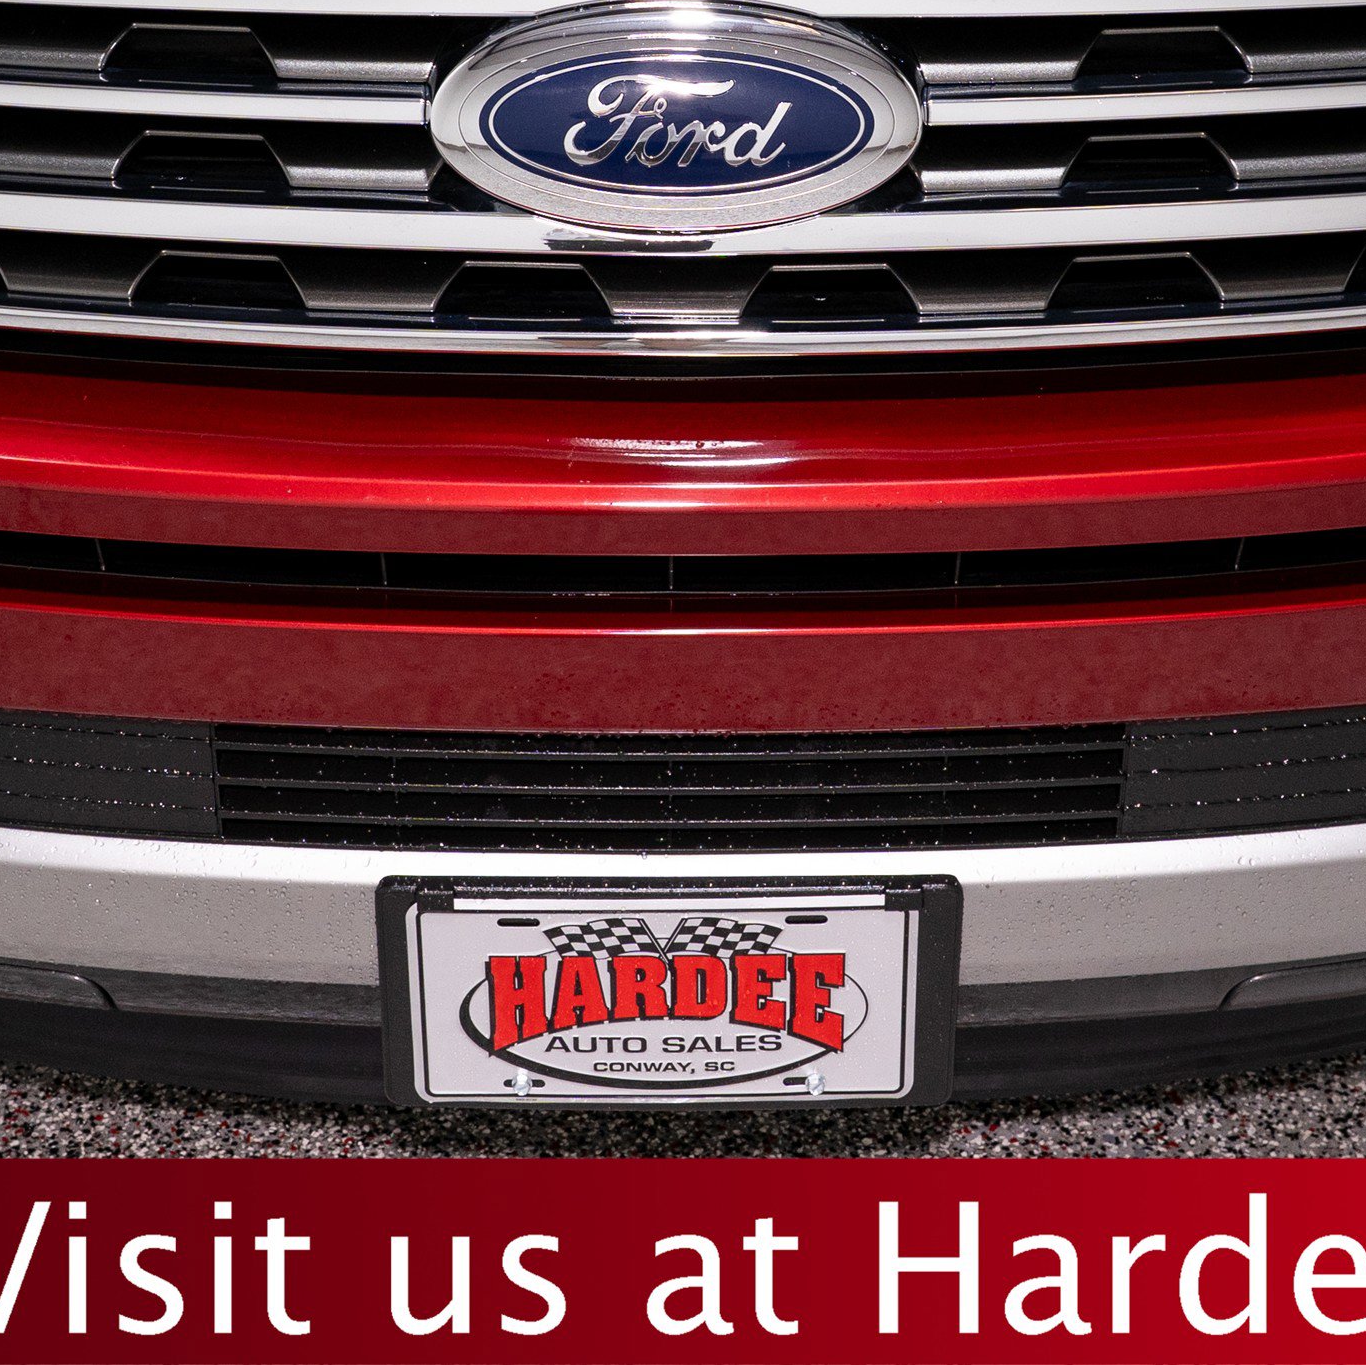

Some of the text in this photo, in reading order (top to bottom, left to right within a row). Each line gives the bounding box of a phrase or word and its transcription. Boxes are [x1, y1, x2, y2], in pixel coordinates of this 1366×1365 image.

[563, 75, 793, 168] Ford
[486, 953, 845, 1054] HARDEE
[544, 1034, 782, 1053] AUTO SALES
[593, 1060, 735, 1074] CONWAY, SC
